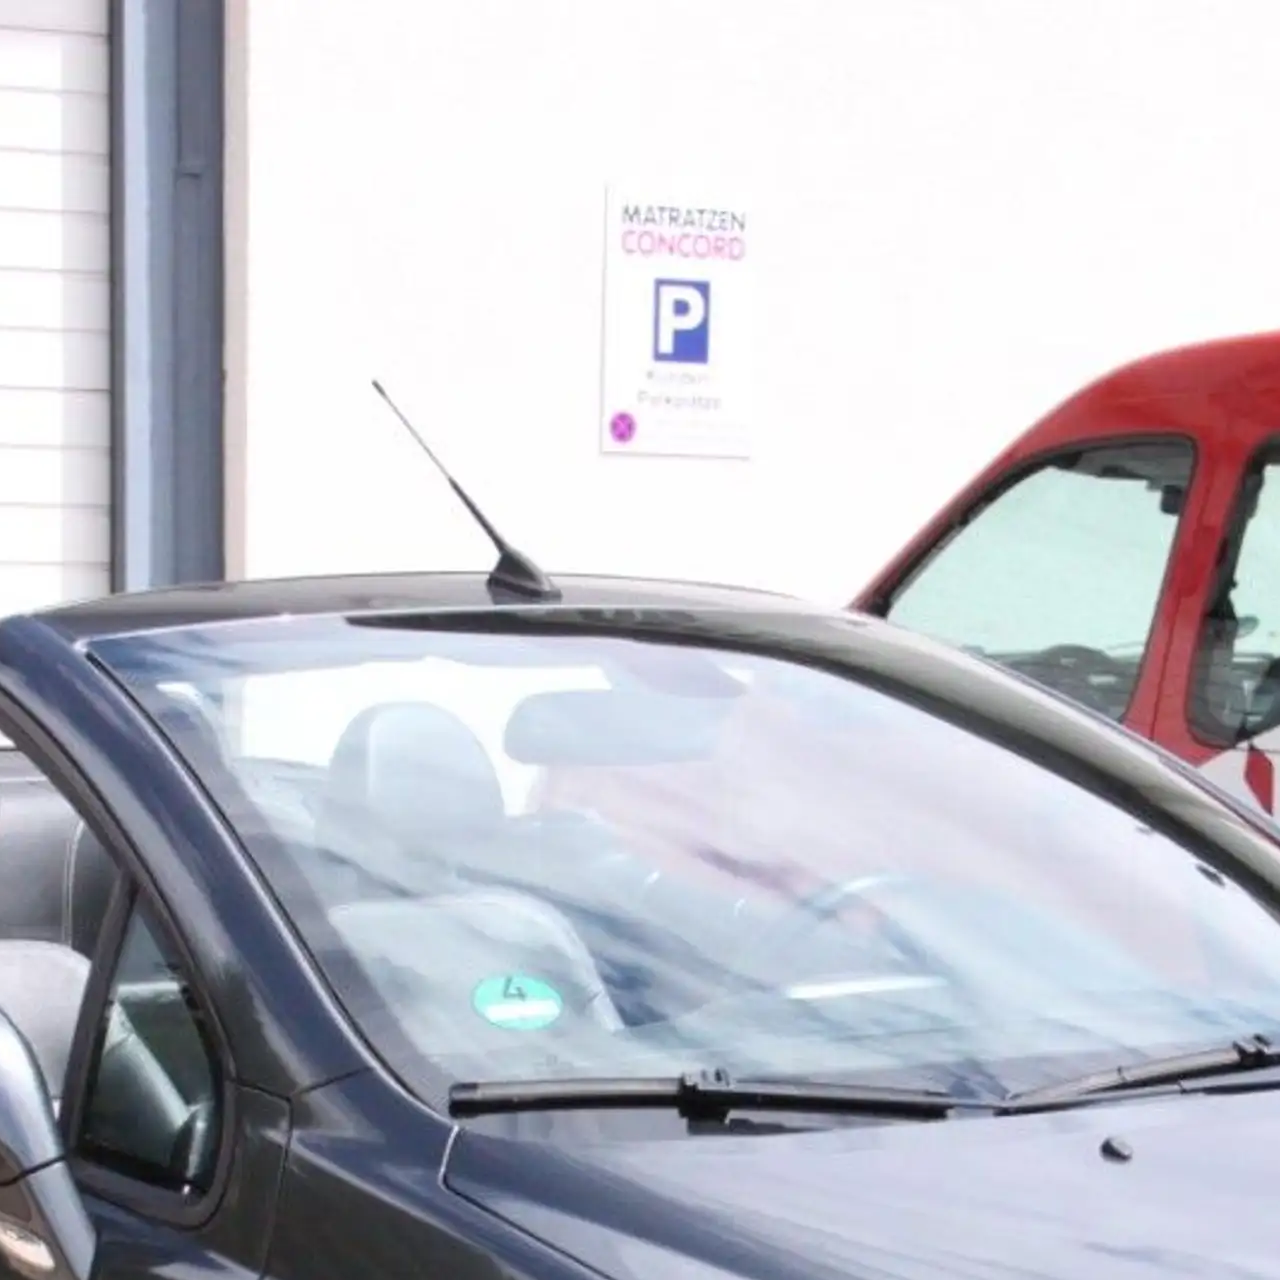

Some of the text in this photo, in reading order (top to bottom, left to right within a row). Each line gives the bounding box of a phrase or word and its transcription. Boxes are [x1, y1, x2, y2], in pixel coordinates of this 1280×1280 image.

[621, 204, 747, 232] MATRATZEN
[621, 229, 747, 261] CONCORD
[657, 283, 706, 356] P
[502, 975, 528, 1002] 4
